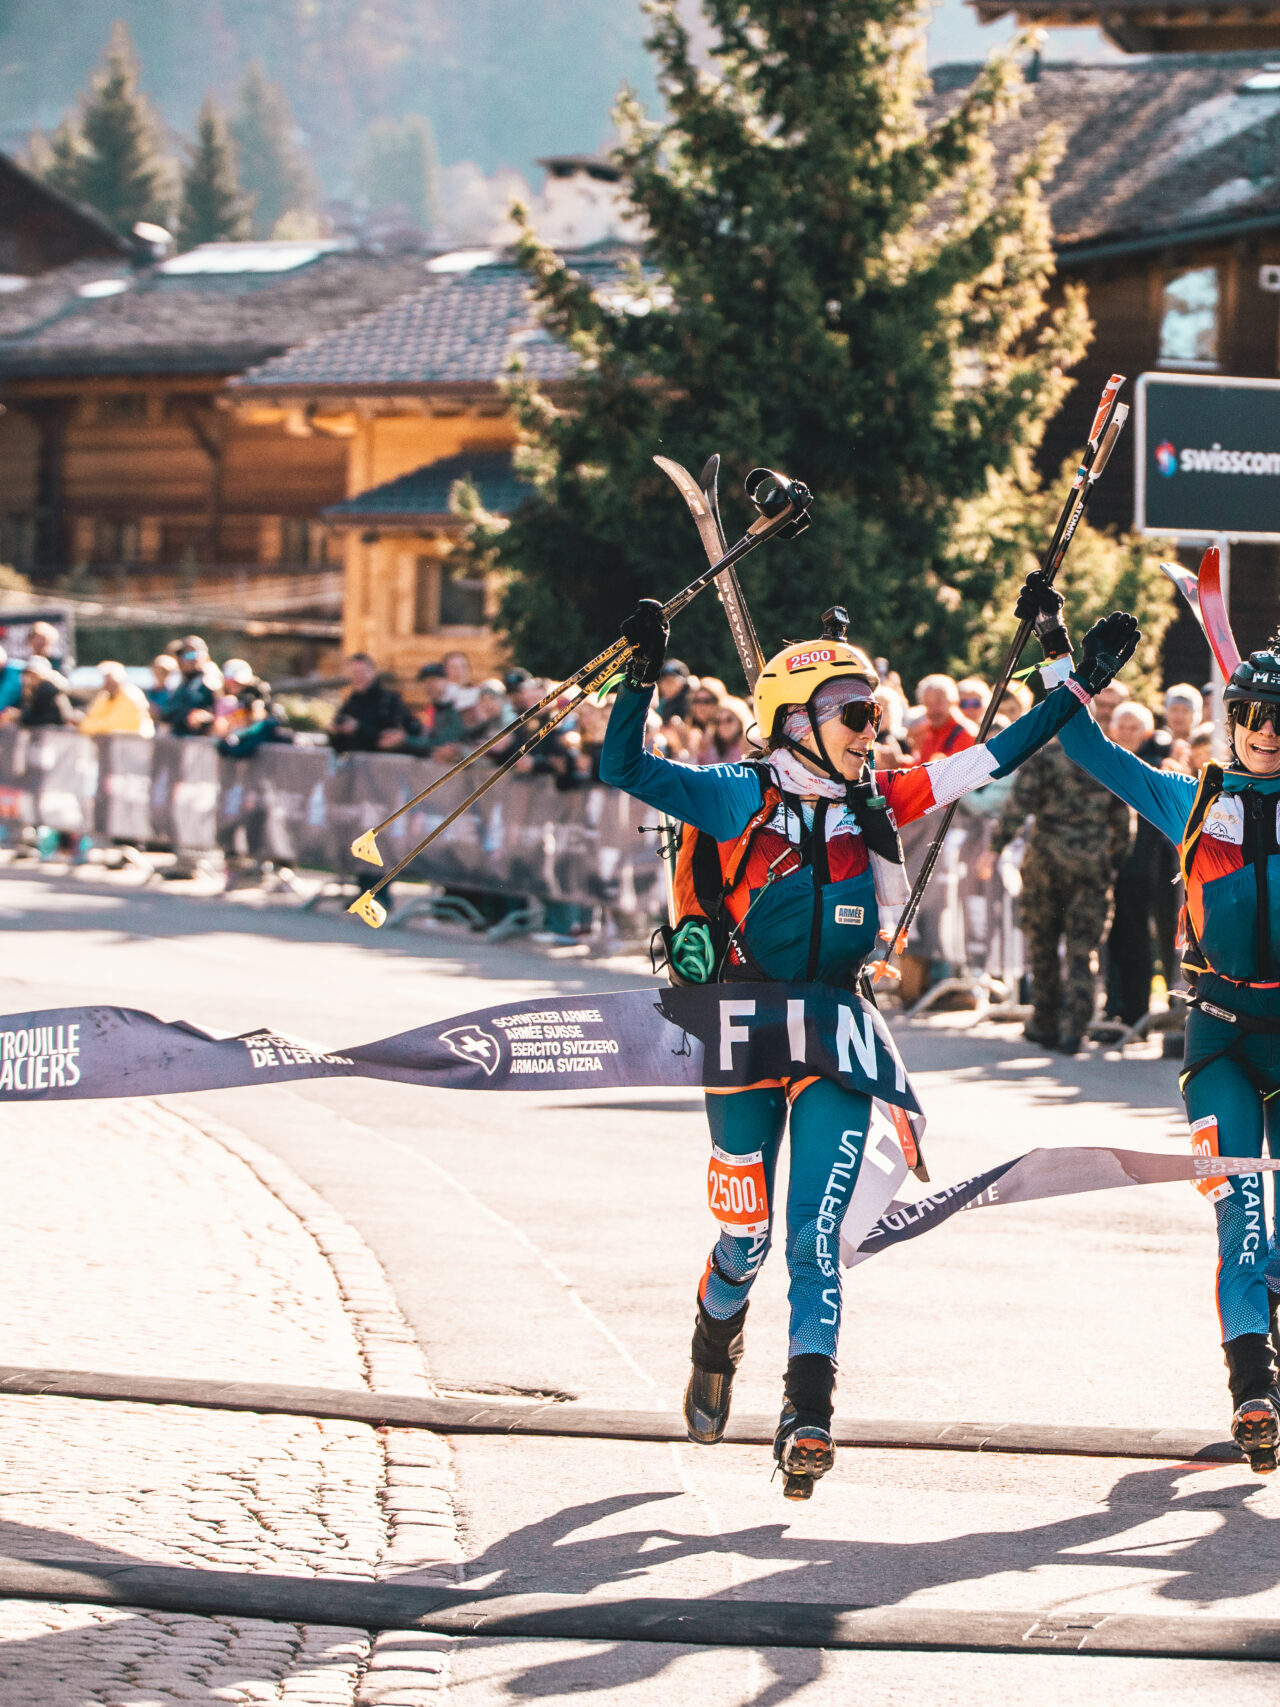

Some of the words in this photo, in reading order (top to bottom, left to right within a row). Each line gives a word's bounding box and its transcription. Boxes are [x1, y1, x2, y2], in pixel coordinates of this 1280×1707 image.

[1064, 501, 1085, 541] ATOMIC
[721, 582, 754, 669] DYNASTAR
[791, 650, 831, 669] 2500
[491, 1011, 562, 1028] SCHWEIZER
[561, 1009, 604, 1023] ARMEE
[543, 1024, 584, 1039] SUISSE
[250, 1048, 279, 1068] DE
[510, 1041, 561, 1057] ESERCITO
[562, 1039, 619, 1055] SVIZZERO
[509, 1058, 556, 1074] ARMADA
[556, 1056, 604, 1073] SVIZRA
[816, 1129, 863, 1278] SPORTIVA
[1238, 1172, 1261, 1266] RANCE
[821, 1288, 838, 1326] LA
